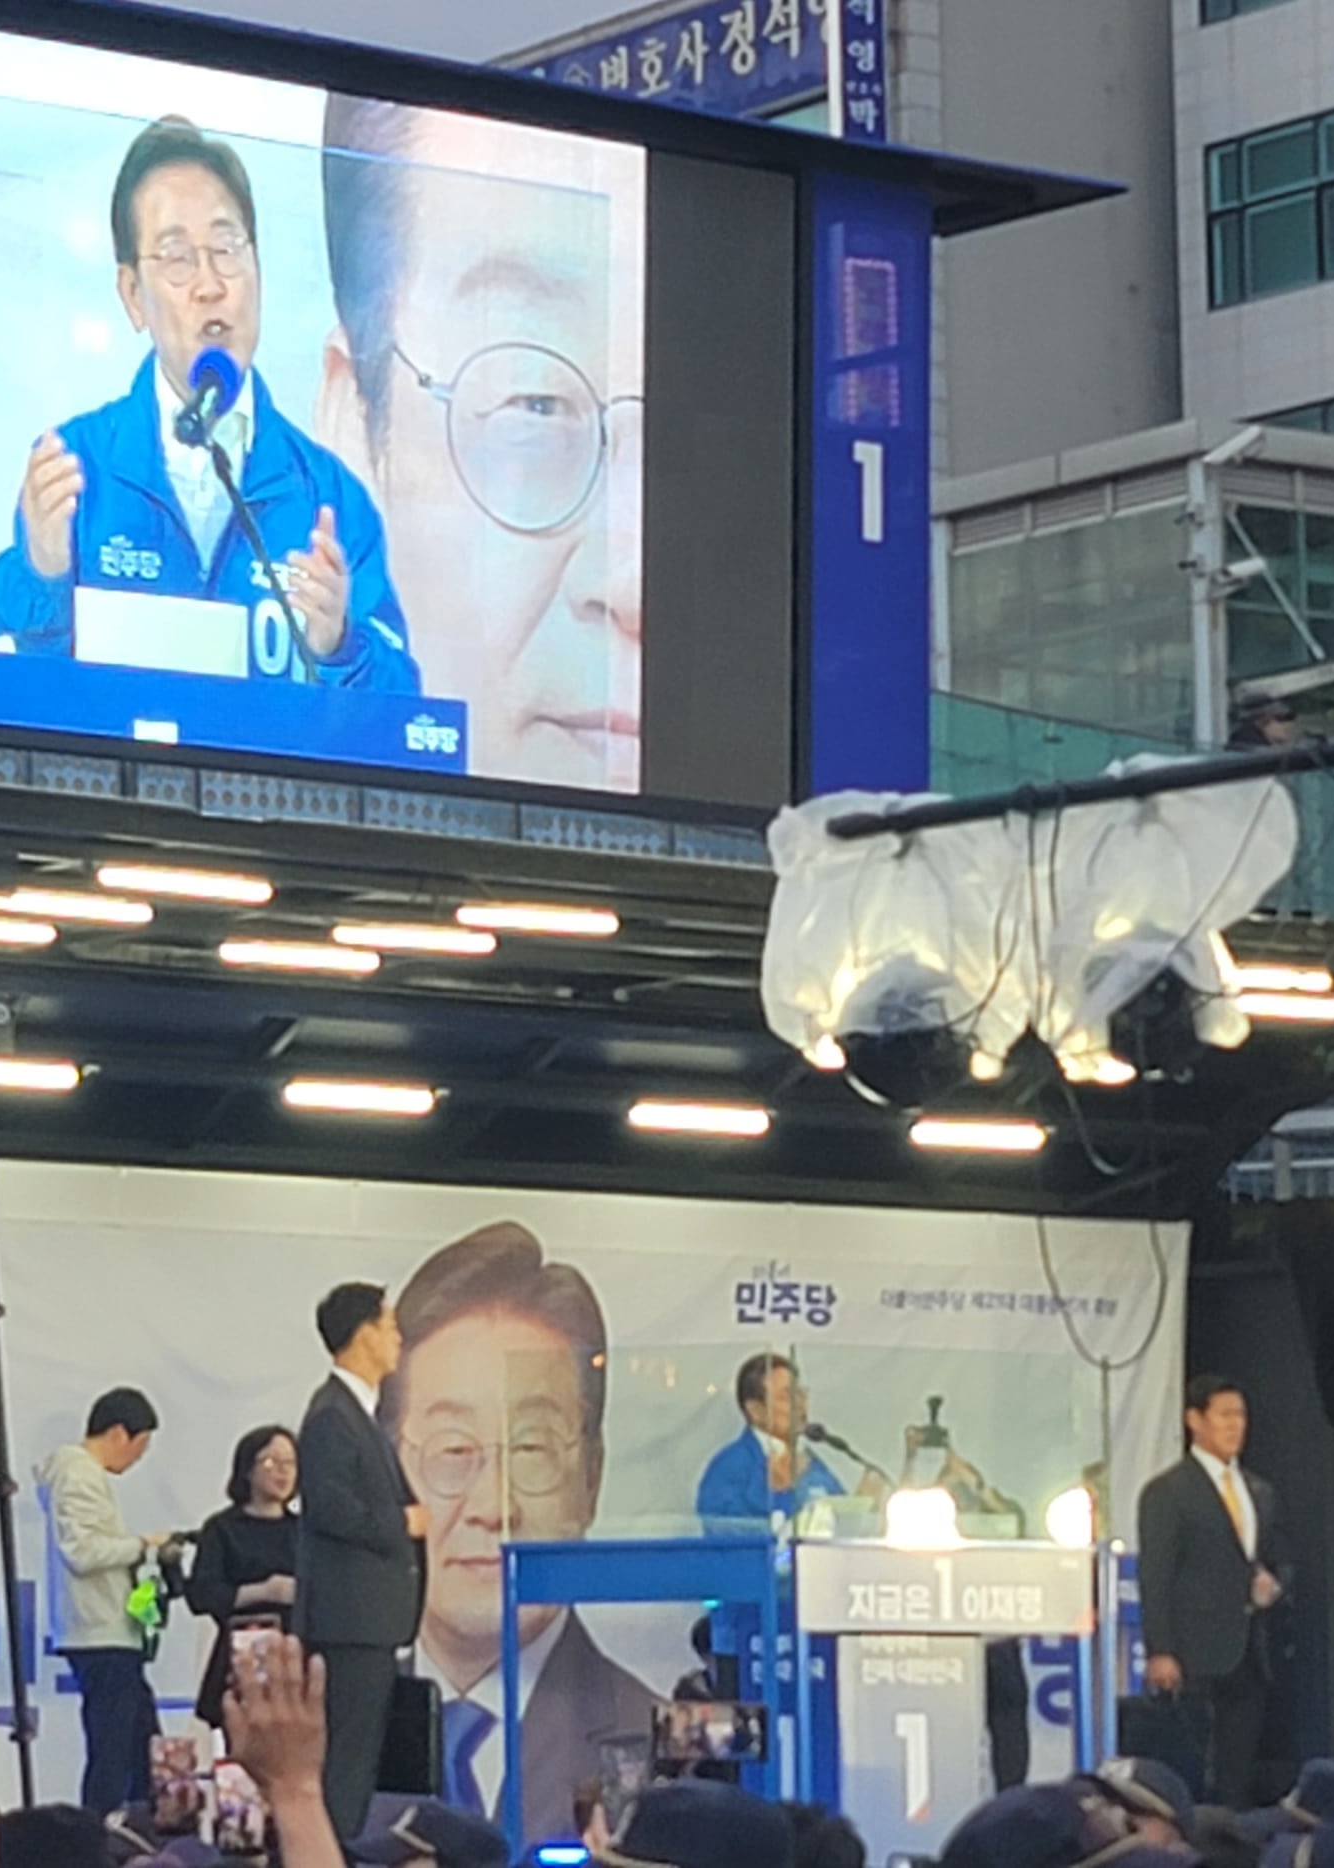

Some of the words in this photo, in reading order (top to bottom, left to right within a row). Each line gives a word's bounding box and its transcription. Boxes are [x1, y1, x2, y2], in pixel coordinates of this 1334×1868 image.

[852, 439, 884, 543] 1
[735, 1281, 839, 1327] 민주당
[847, 1583, 933, 1622] 지금은
[934, 1557, 954, 1621] 1
[961, 1584, 1043, 1623] 이재명
[894, 1712, 930, 1822] 1
